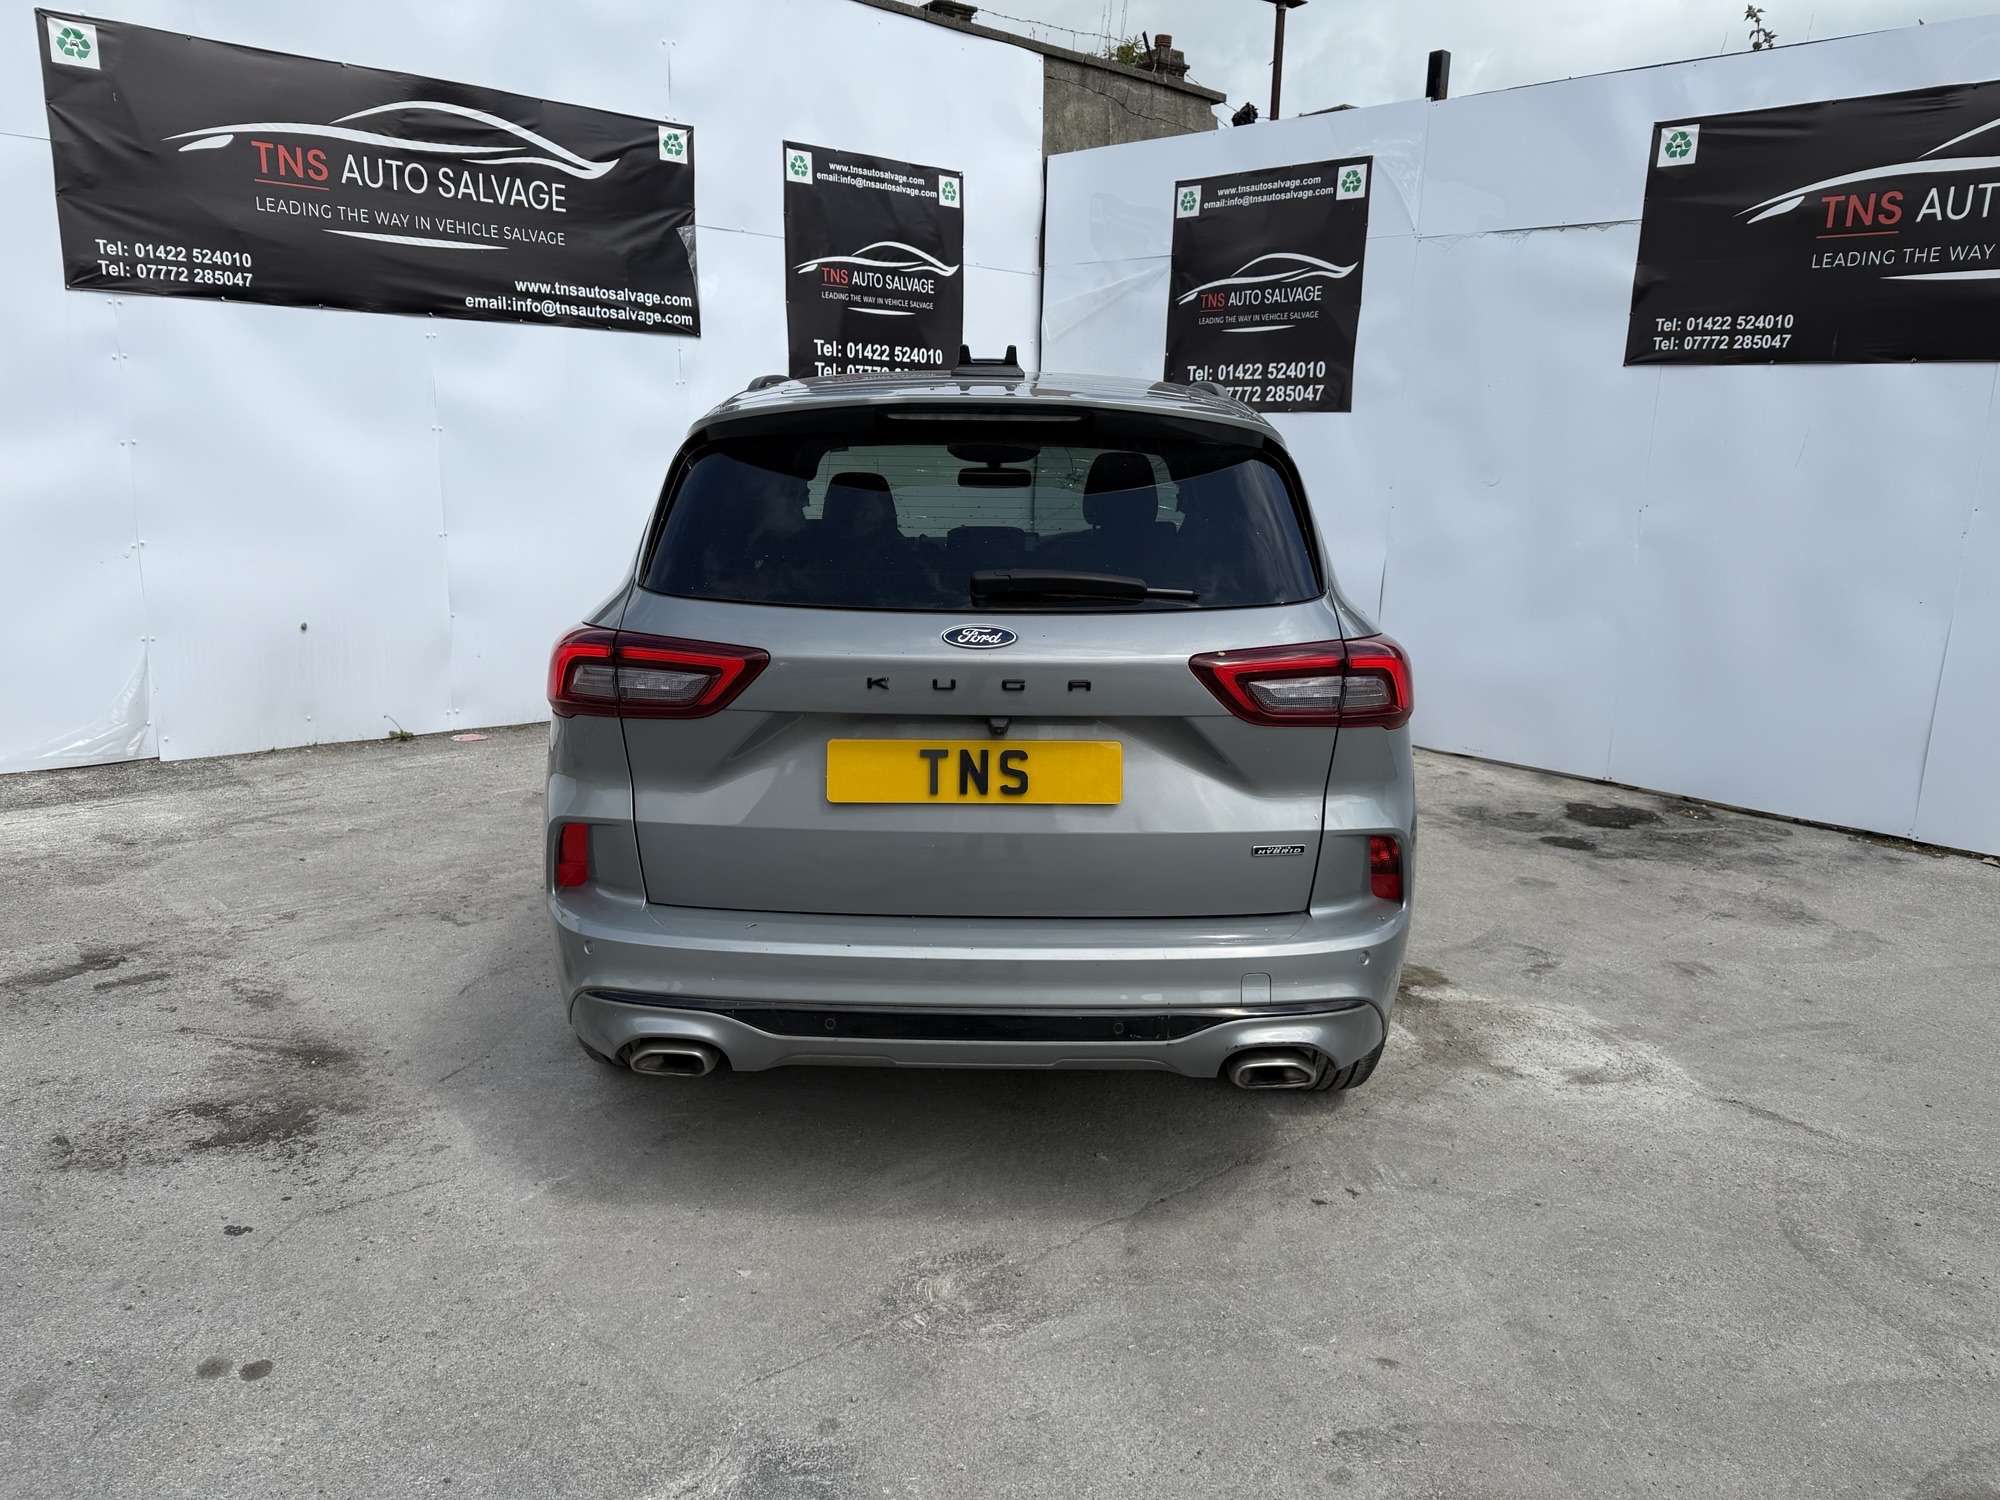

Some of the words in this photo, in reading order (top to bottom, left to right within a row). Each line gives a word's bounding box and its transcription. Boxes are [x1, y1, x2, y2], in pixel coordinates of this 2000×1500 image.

[251, 140, 329, 181] TNS
[341, 153, 428, 195] AUTO
[438, 167, 567, 212] SALVAGE
[817, 171, 938, 199] email:info@tnsautosalvage.com
[829, 162, 925, 186] www.tnsautosalvage.com
[1217, 176, 1321, 196] www.tnsautosalvage.com
[1203, 186, 1334, 210] email:info@tnsautosalvage.com
[1821, 191, 1904, 228] TNS
[1915, 182, 2000, 222] AUT
[255, 196, 332, 219] LEADING
[337, 206, 369, 223] THE
[374, 210, 410, 228] WAY
[415, 216, 431, 232] IN
[435, 218, 499, 239] VEHICLE
[503, 226, 566, 246] SALVAGE
[95, 239, 129, 258] Tel:
[134, 243, 187, 262] 01422
[192, 248, 252, 268] 524010
[1811, 249, 1896, 269] LEADING
[1903, 246, 1942, 263] THE
[1949, 243, 1996, 261] WAY
[98, 260, 130, 278] Tel:
[136, 264, 189, 282] 07772
[194, 269, 253, 288] 285047
[822, 267, 848, 283] TNS
[852, 271, 883, 288] AUTO
[886, 275, 934, 294] SALVAGE
[514, 280, 692, 307] www.tnsautosalvage.com
[822, 291, 849, 301] LEADING
[850, 293, 861, 303] THE
[862, 295, 876, 305] WAY
[877, 297, 883, 305] IN
[884, 298, 909, 308] VEHICLE
[910, 300, 934, 310] SALVAGE
[1200, 293, 1225, 308] TNS
[1228, 290, 1262, 307] AUTO
[1264, 285, 1323, 304] SALVAGE
[465, 296, 693, 326] email:info@tnsautosalvage.com
[1199, 315, 1224, 325] LEADING
[1225, 315, 1237, 323] THE
[1238, 314, 1252, 323] WAY
[1253, 313, 1260, 322] IN
[1262, 312, 1289, 321] VEHICLE
[1290, 310, 1319, 320] SALVAGE
[1655, 317, 1682, 332] Tel:
[1686, 316, 1732, 331] 01422
[1736, 314, 1794, 330] 524010
[814, 339, 842, 357] Tel:
[847, 342, 890, 361] 01422
[894, 346, 943, 364] 524010
[1653, 336, 1680, 351] Tel:
[1684, 335, 1729, 350] 07772
[1733, 333, 1792, 349] 285047
[1187, 365, 1213, 381] Tel:
[1218, 363, 1263, 380] 01422
[1267, 361, 1326, 379] 524010
[1226, 386, 1261, 402] 7772
[1265, 384, 1325, 402] 285047
[957, 628, 1003, 643] Ford
[866, 677, 1092, 692] KUGA
[919, 749, 1029, 796] TNS
